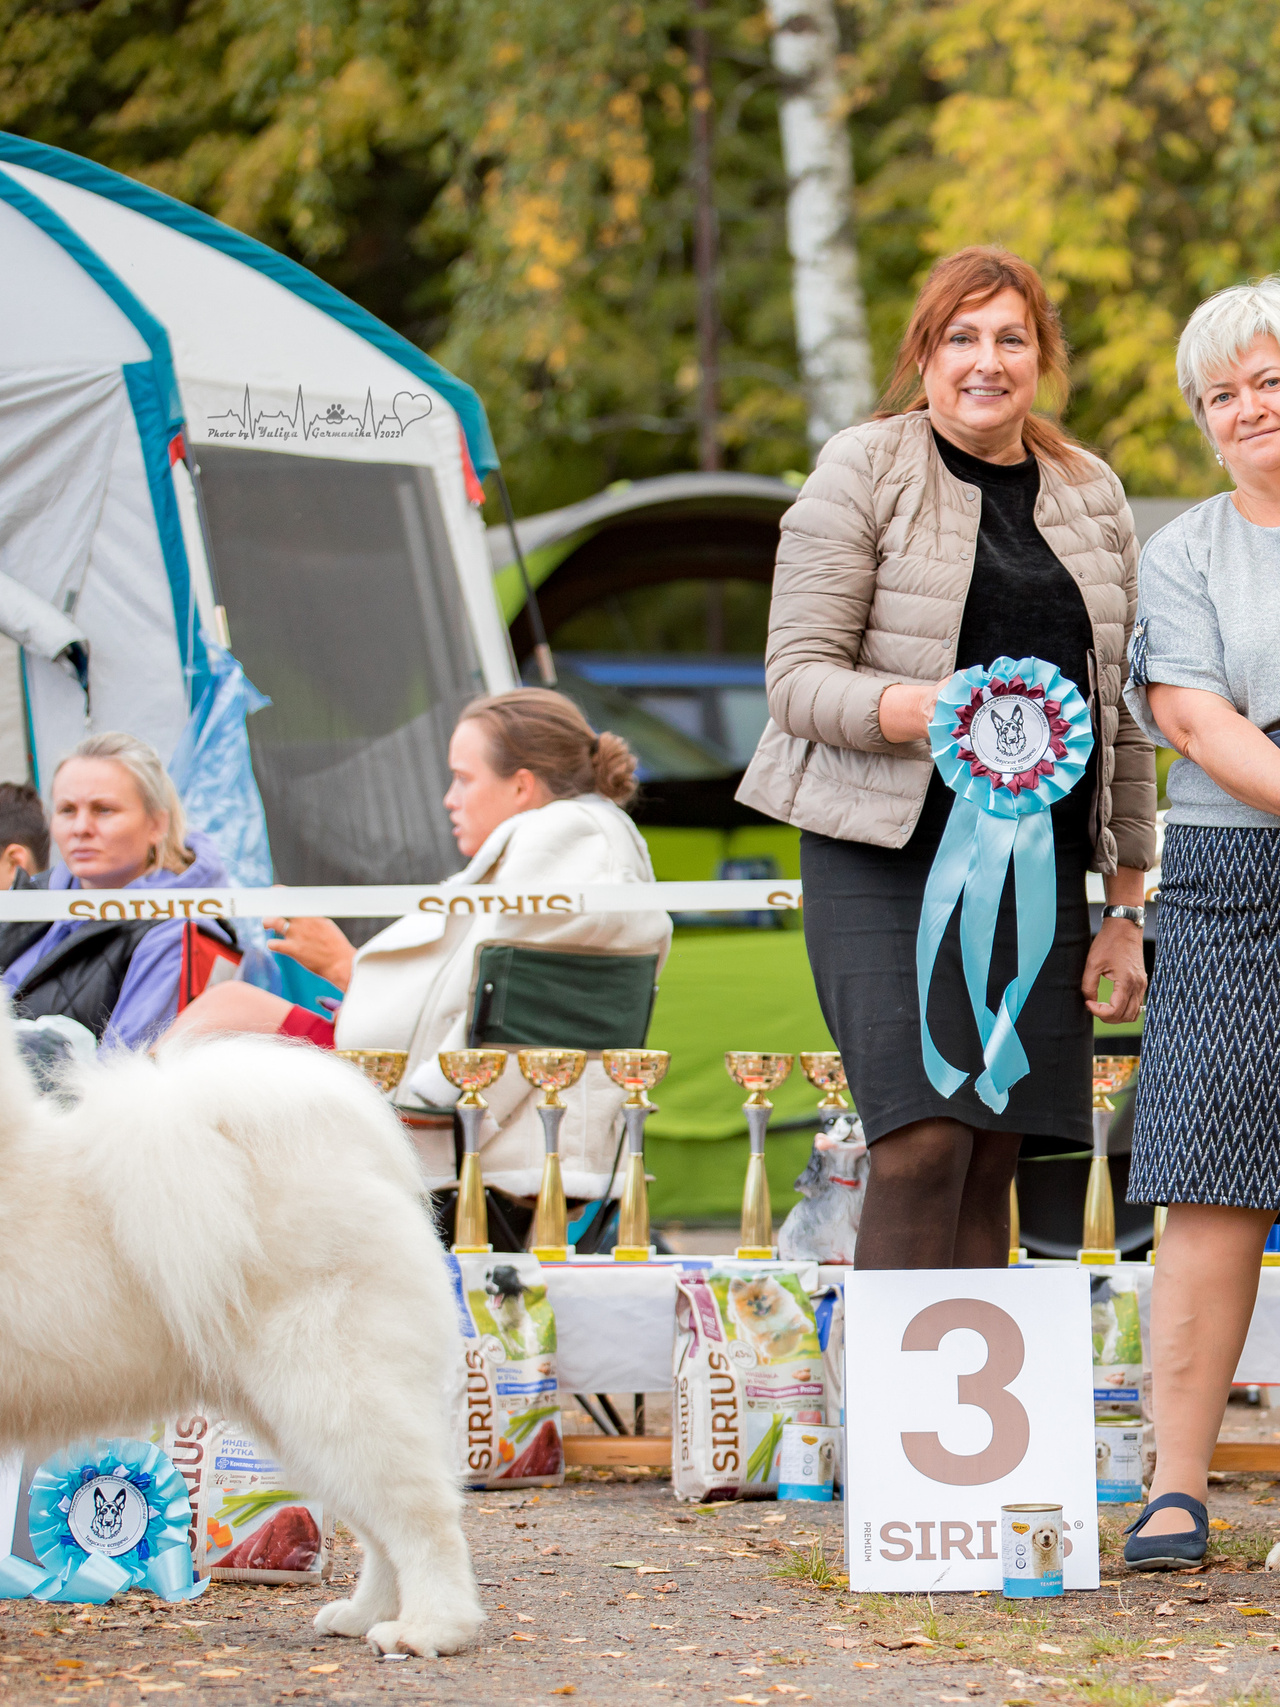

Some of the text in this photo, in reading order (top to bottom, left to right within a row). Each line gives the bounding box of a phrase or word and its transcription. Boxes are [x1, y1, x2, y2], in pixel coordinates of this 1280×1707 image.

[230, 1447, 254, 1456] УТКА
[466, 1350, 493, 1470] SIRIUS
[709, 1351, 740, 1472] SIRIUS
[900, 1298, 1030, 1486] 3
[864, 1521, 872, 1562] PREMIUM
